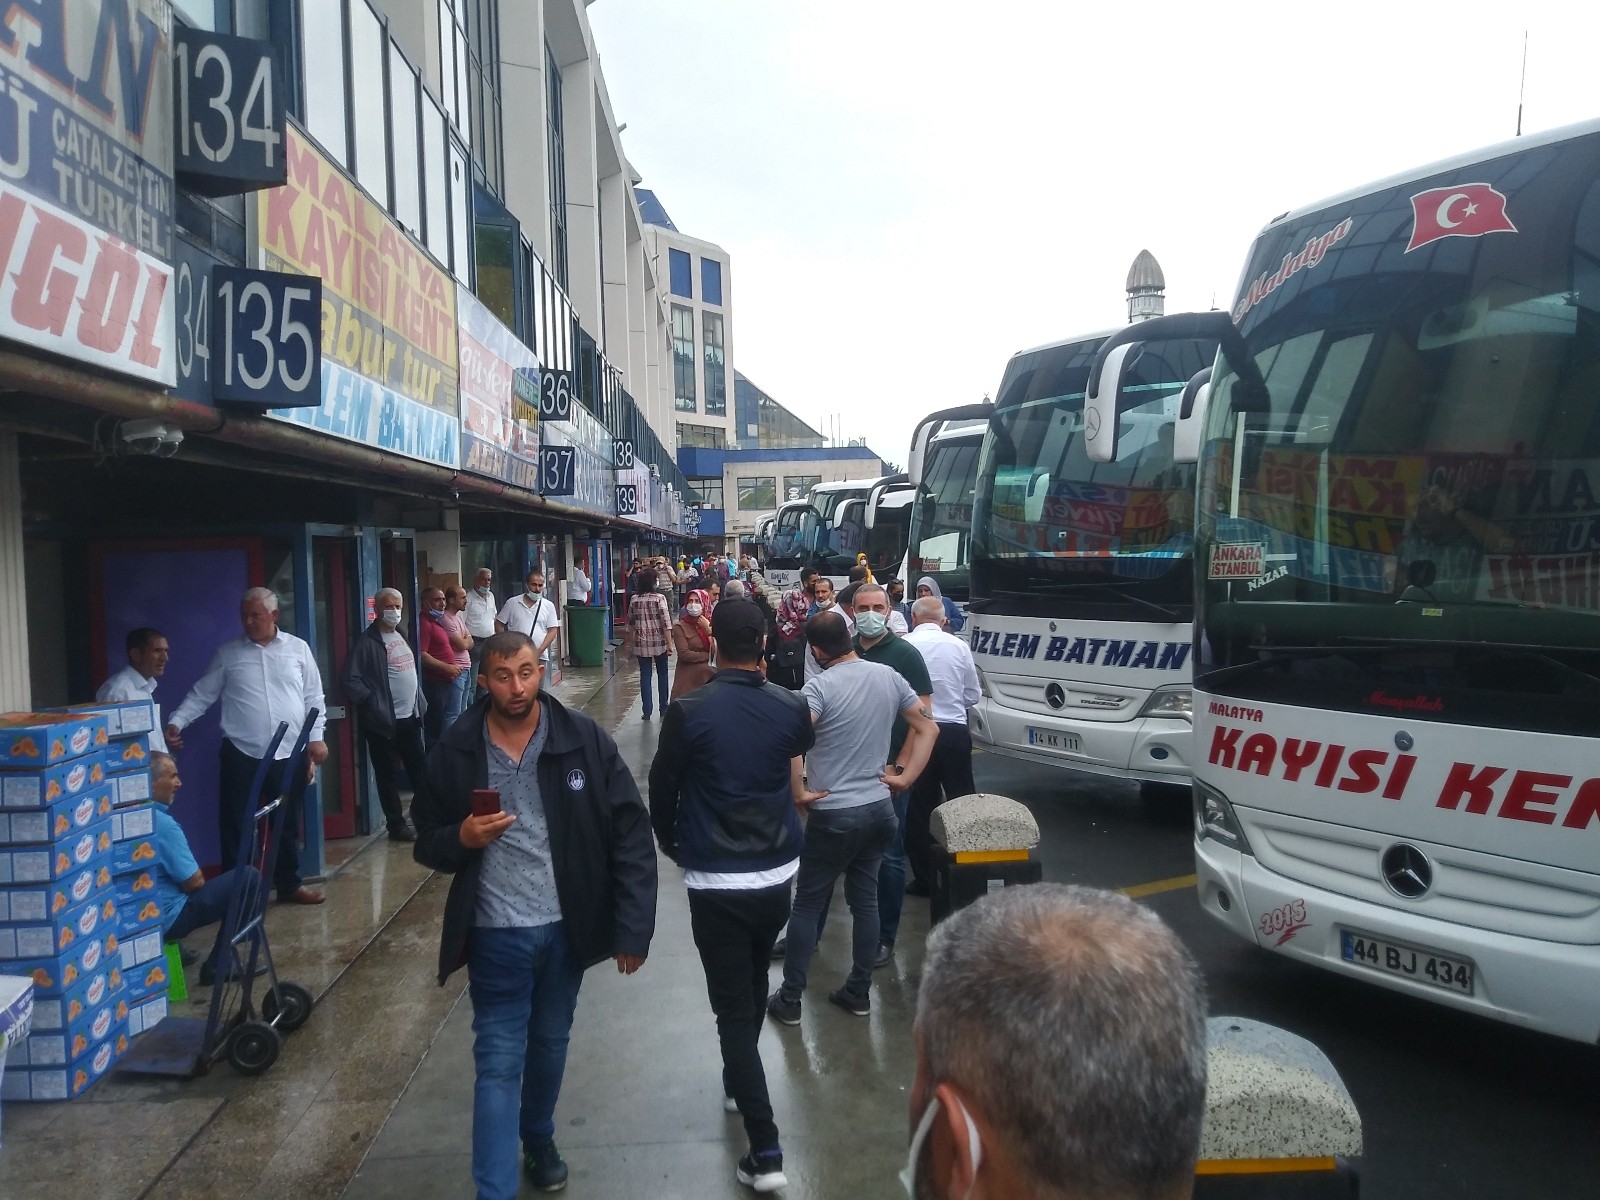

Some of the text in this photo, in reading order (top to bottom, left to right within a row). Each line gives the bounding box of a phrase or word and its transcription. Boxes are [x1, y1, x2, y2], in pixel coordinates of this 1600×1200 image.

[176, 42, 280, 168] 134
[286, 133, 448, 310] MALATYA
[1232, 216, 1353, 325] Malatya
[218, 280, 313, 392] 135
[321, 298, 397, 385] abur
[402, 344, 441, 405] tur
[378, 392, 456, 465] BATMAN
[539, 449, 573, 490] 137
[613, 441, 633, 467] 138
[616, 487, 636, 512] 139
[1213, 545, 1262, 561] ANKARA
[1247, 565, 1288, 592] NAZAR
[970, 626, 1192, 670] ÖZLEM BATMAN
[1208, 701, 1264, 723] MALATYA
[1035, 732, 1078, 750] 14 KK 111
[1258, 898, 1307, 936] 2015
[1354, 939, 1468, 988] 44 BJ 434
